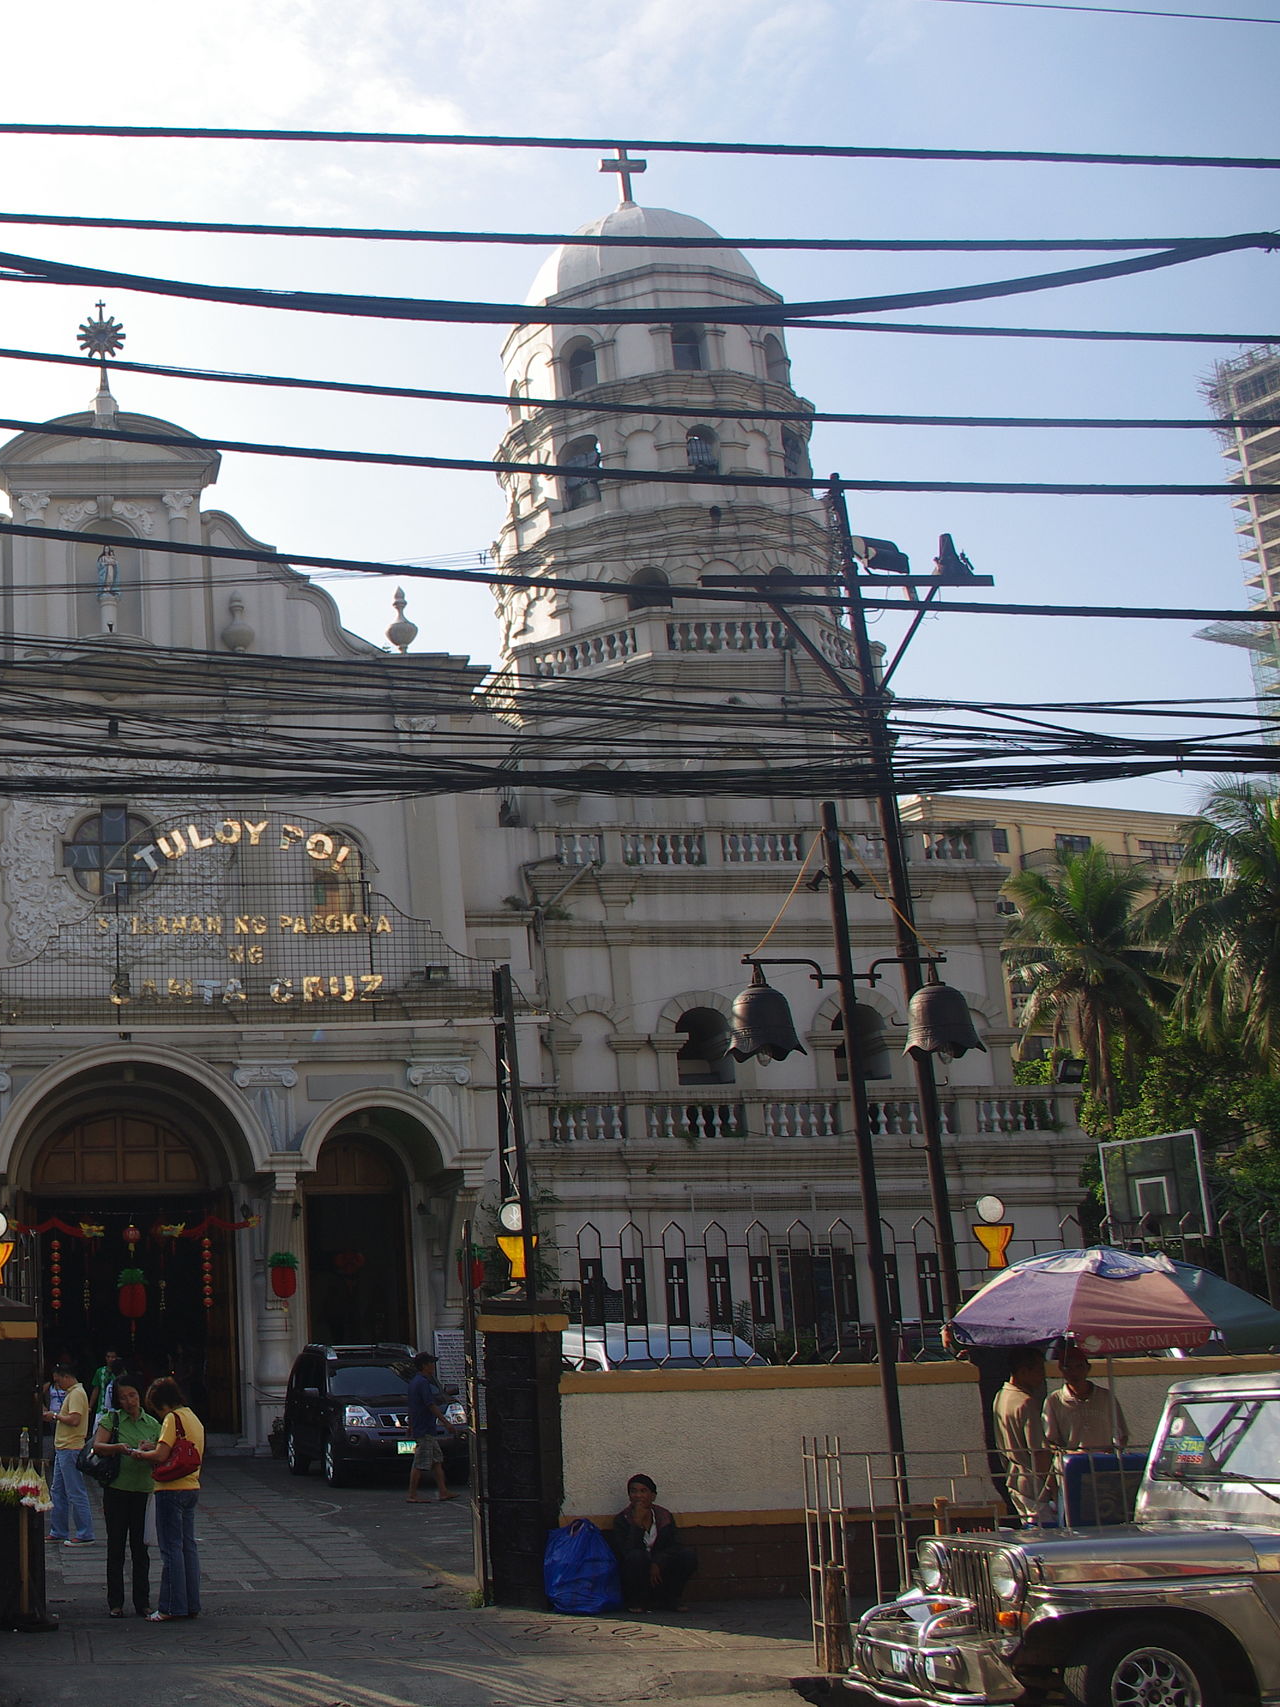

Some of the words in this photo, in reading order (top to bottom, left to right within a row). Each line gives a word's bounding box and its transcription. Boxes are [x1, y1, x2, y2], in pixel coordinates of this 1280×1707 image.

[133, 818, 269, 872] TULOY
[279, 824, 350, 872] PO!
[234, 914, 267, 935] NG
[109, 977, 248, 1006] SANTA
[270, 974, 384, 1004] CRUZ
[1106, 1332, 1207, 1350] MICROMATIC
